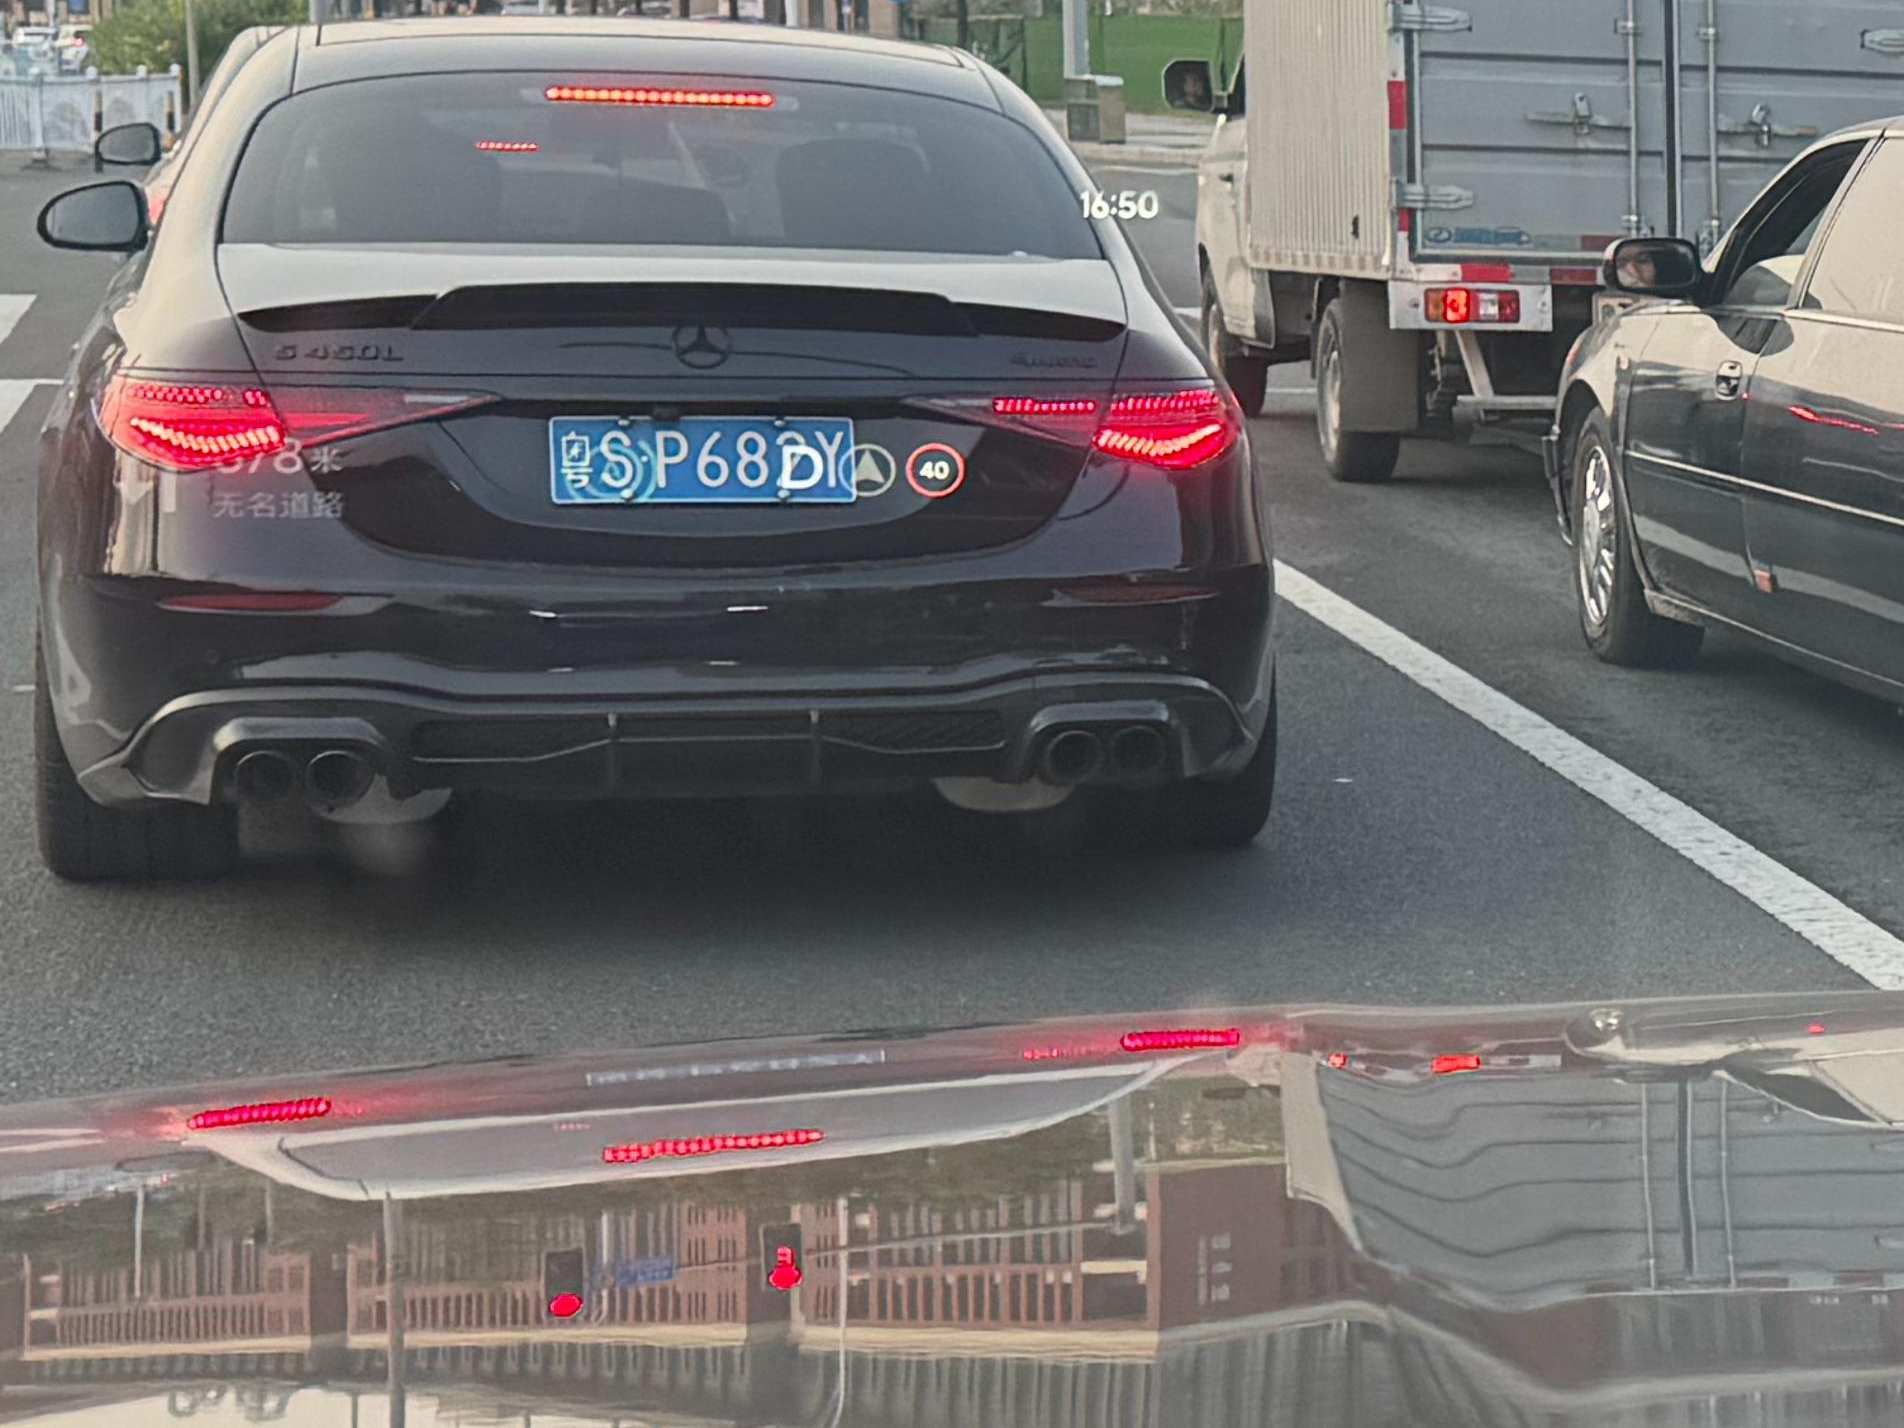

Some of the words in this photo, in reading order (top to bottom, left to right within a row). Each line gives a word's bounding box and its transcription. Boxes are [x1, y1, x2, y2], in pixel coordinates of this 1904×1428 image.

[1080, 189, 1160, 220] 16:50
[918, 460, 951, 481] 40
[213, 490, 344, 520] 无名道路
